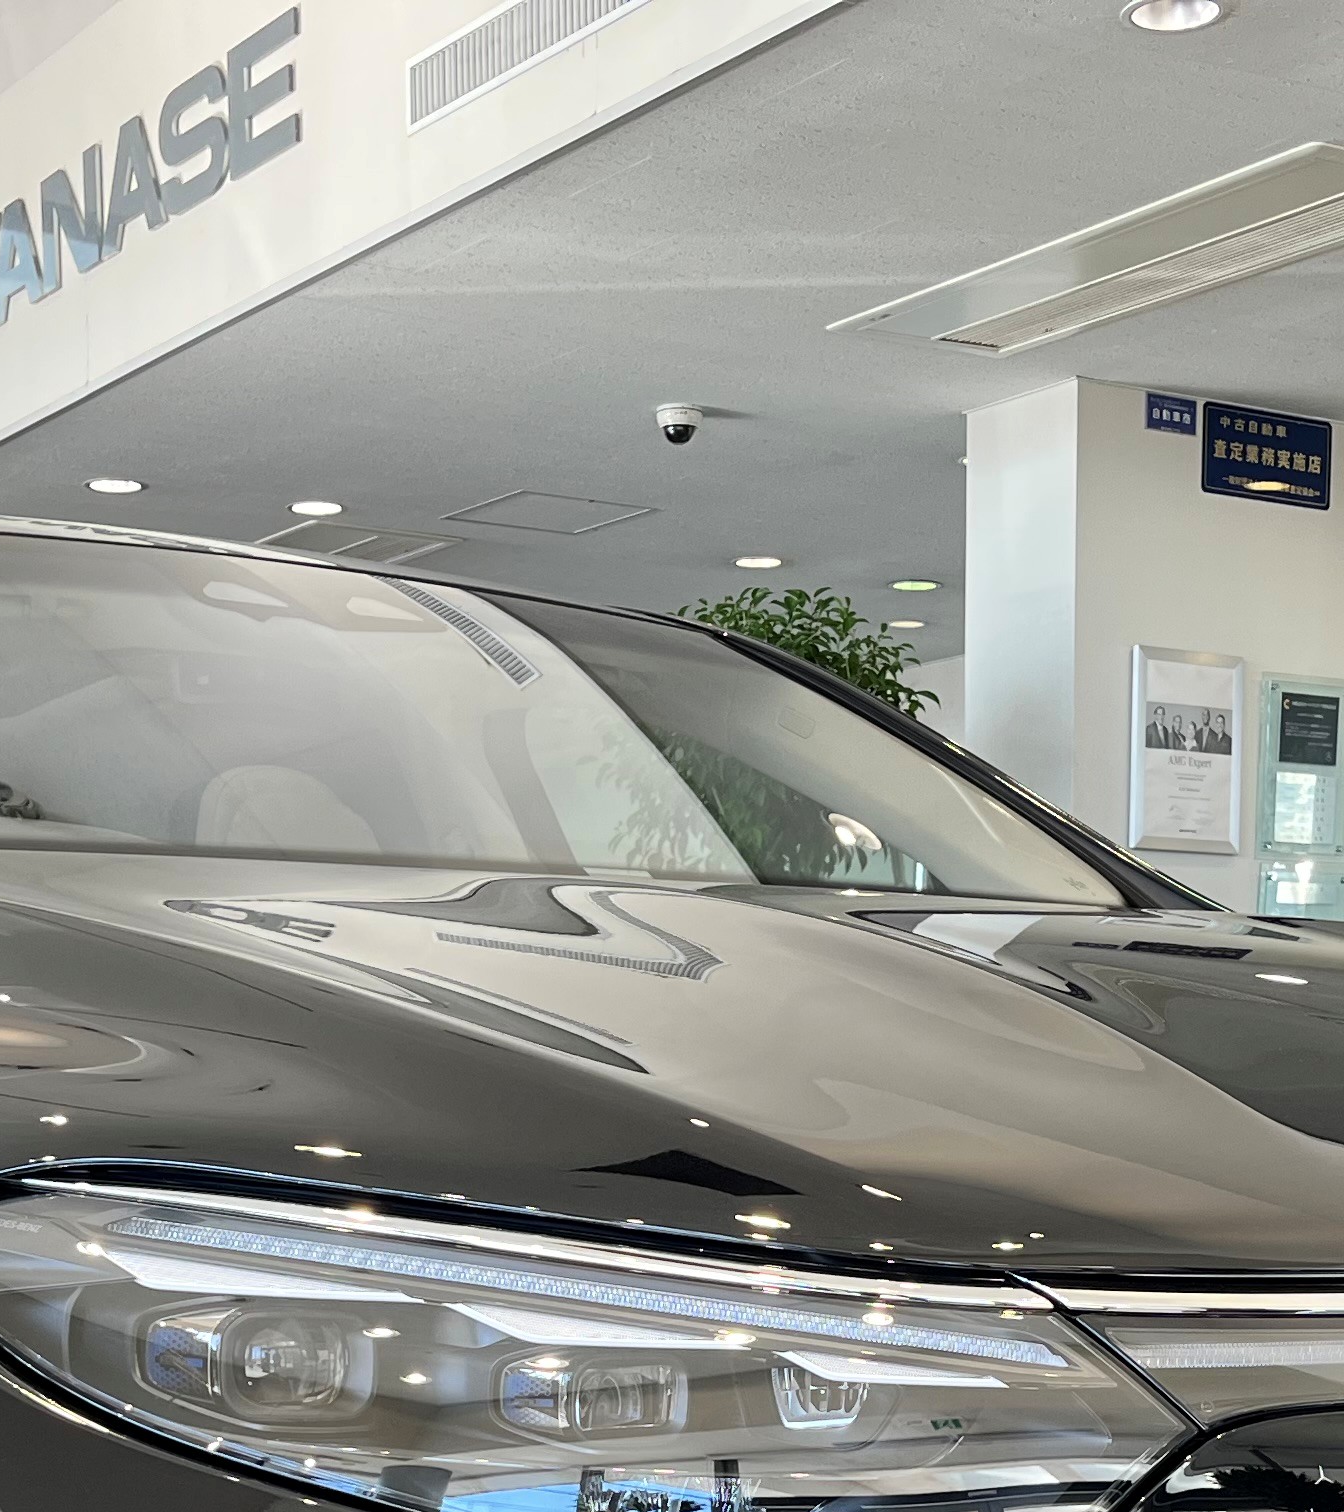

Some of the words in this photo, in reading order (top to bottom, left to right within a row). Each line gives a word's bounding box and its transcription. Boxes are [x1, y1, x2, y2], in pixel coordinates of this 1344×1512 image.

[1219, 415, 1288, 438] 中古自動車
[1213, 439, 1322, 474] 査定業務実施店
[1188, 757, 1212, 769] Expert
